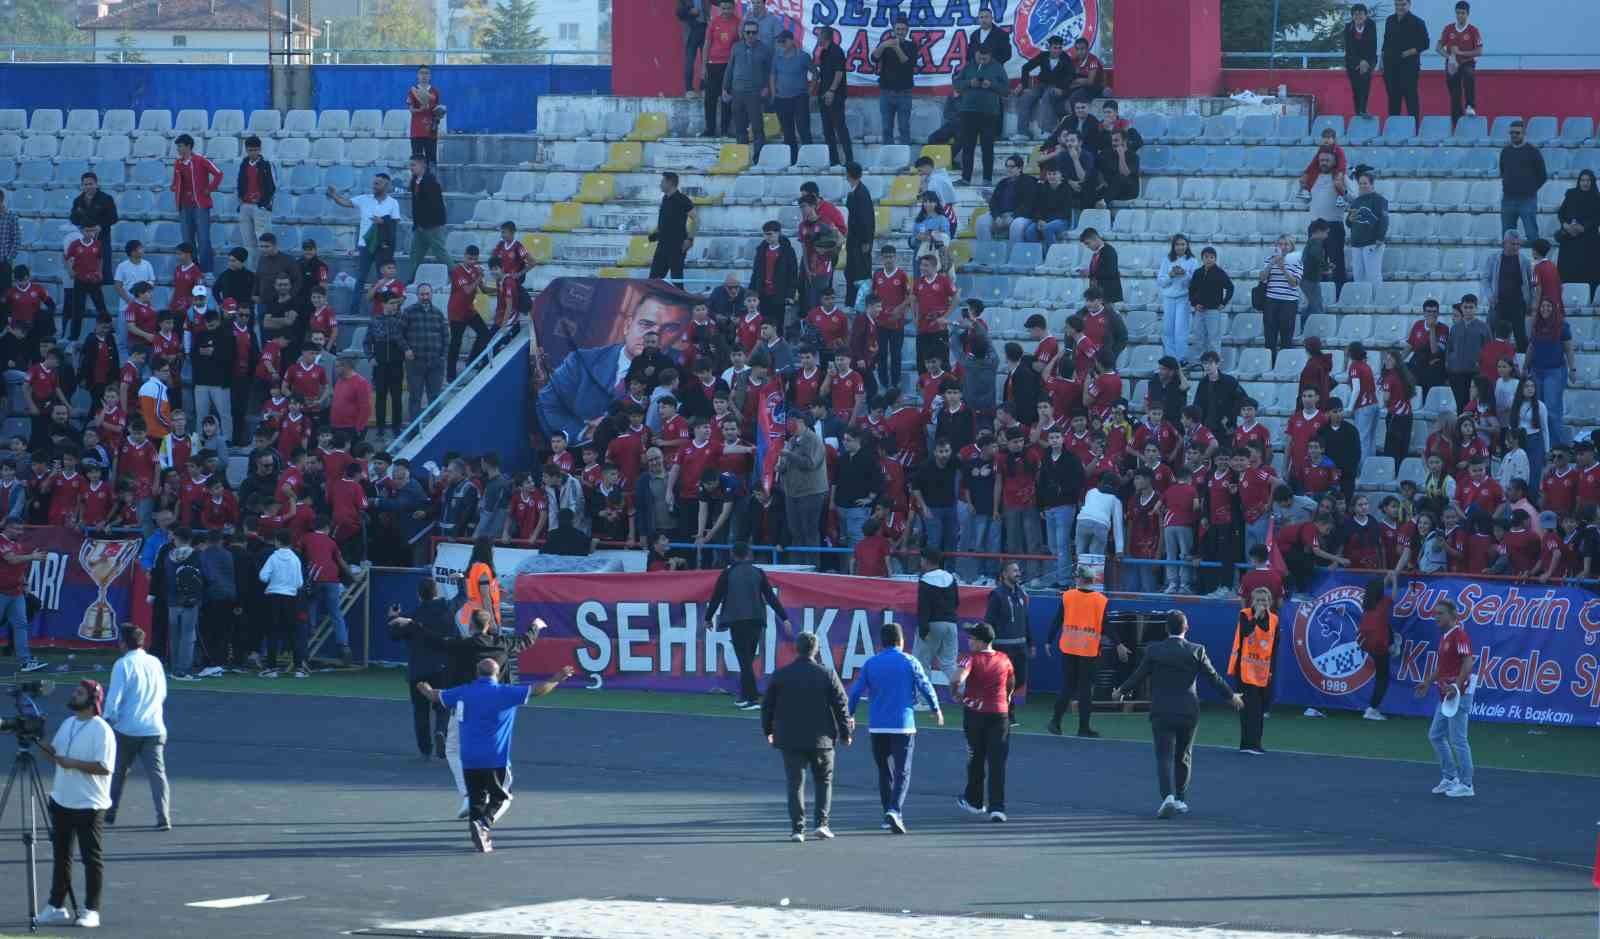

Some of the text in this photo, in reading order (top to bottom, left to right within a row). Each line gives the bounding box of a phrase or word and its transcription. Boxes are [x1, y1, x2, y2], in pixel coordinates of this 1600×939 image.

[811, 0, 1008, 27] SERKAN
[25, 551, 69, 610] ARI
[1392, 580, 1448, 621] Bu
[1455, 583, 1572, 631] Şehrin
[1320, 679, 1348, 692] 1989
[1507, 704, 1521, 719] Fk
[1525, 706, 1575, 725] Başkanı
